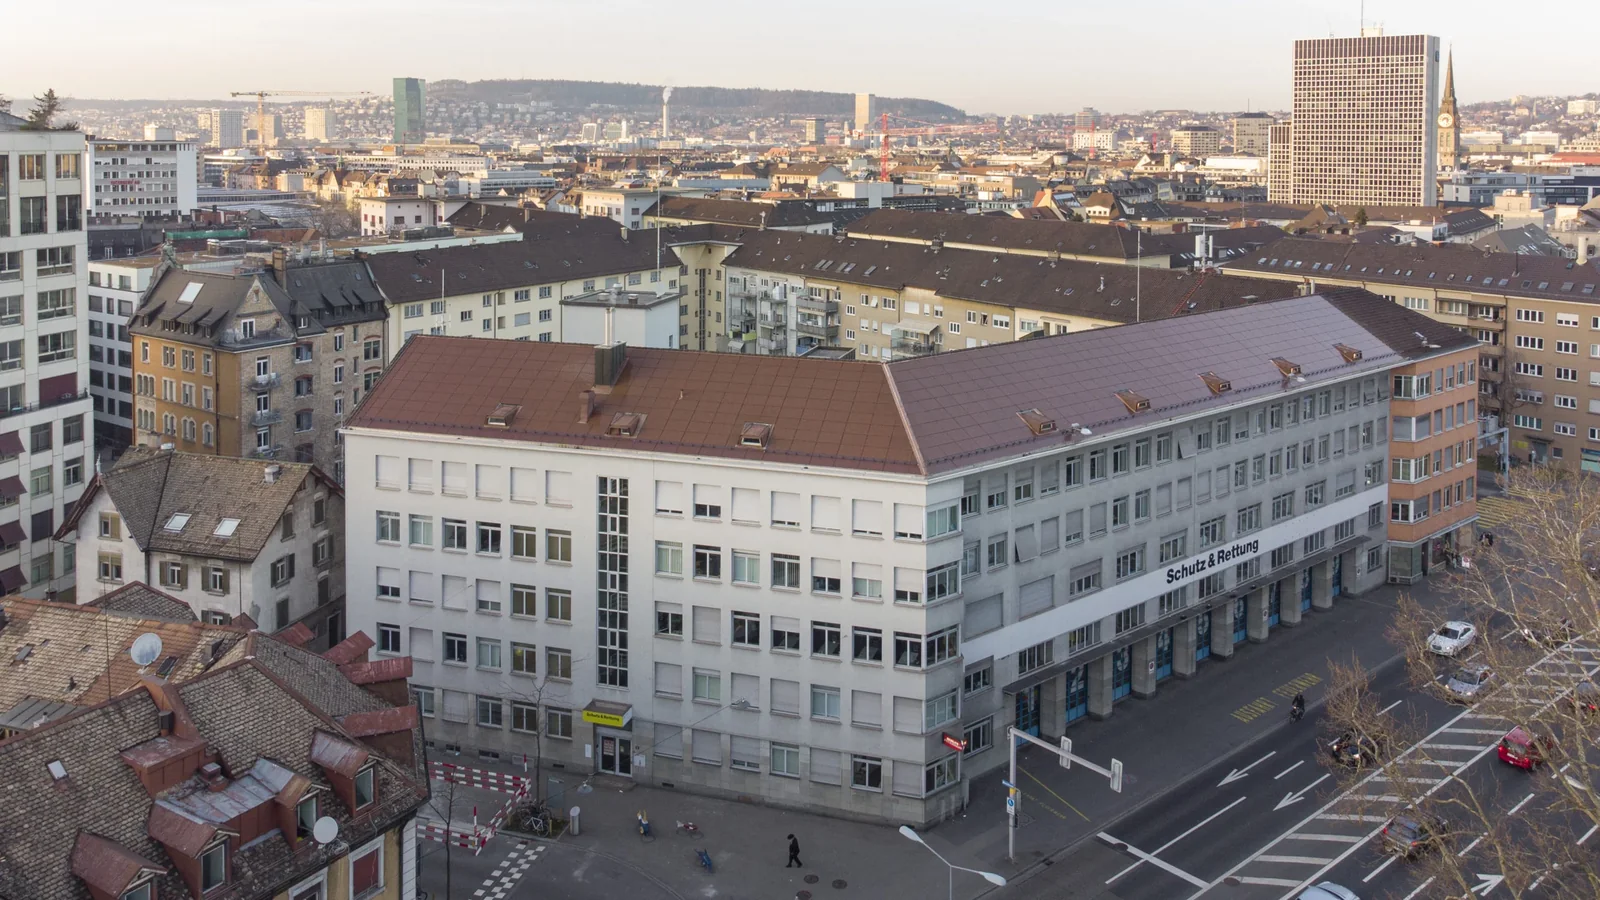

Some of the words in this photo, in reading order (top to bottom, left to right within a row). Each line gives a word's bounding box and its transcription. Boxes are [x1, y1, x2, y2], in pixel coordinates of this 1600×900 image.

[1166, 559, 1206, 584] Schutz
[1208, 553, 1215, 568] &
[1217, 539, 1259, 564] Rettung
